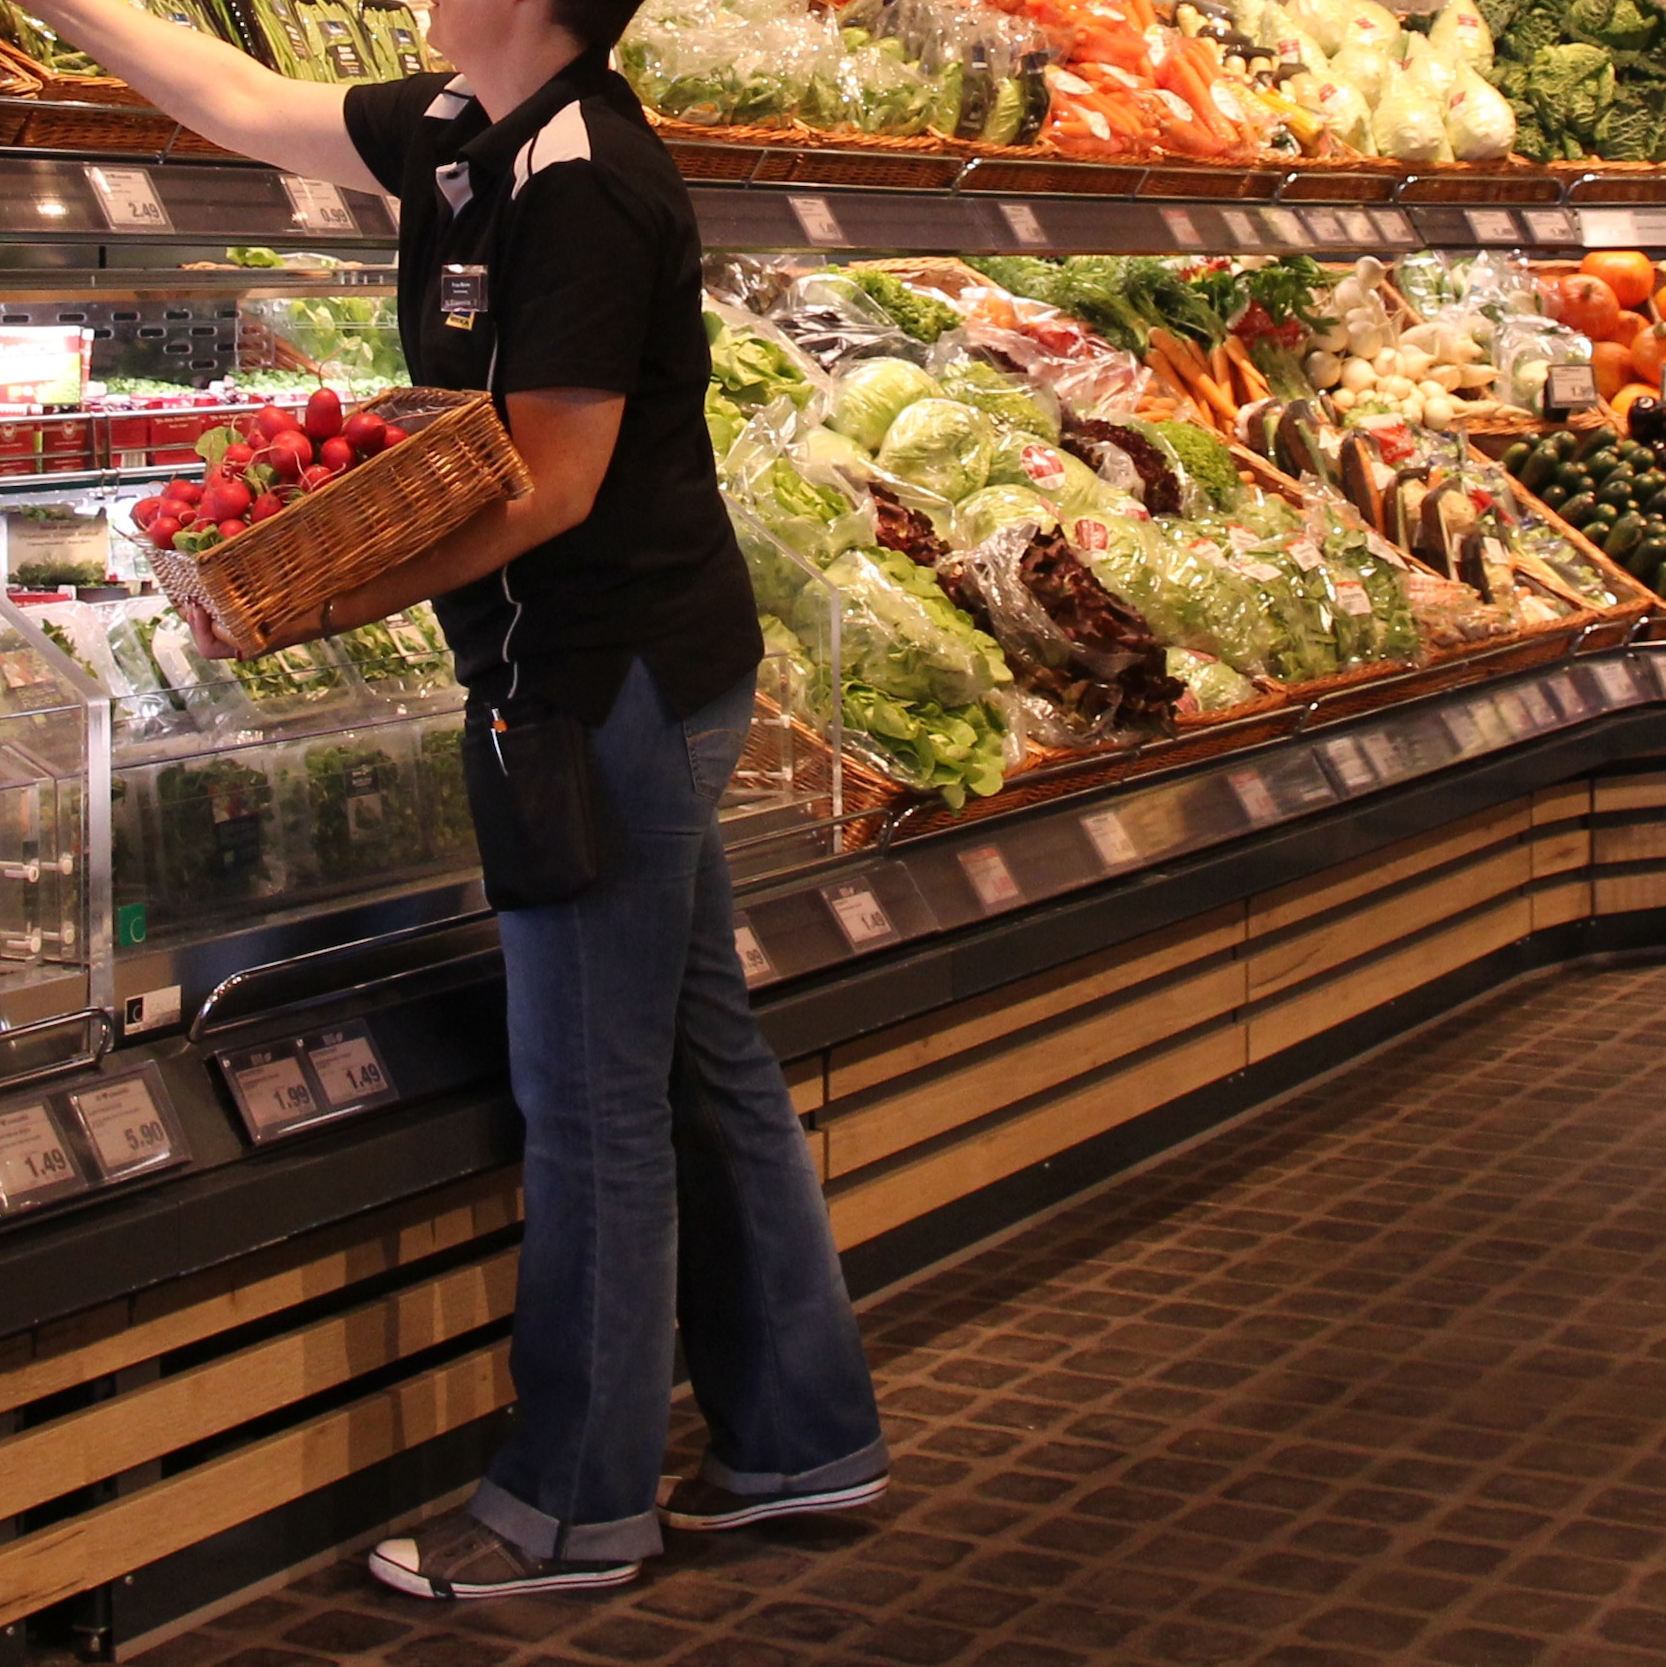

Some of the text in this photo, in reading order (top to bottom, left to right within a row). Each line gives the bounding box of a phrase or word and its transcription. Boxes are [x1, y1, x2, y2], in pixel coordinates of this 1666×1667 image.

[346, 1063, 381, 1090] 1.49
[274, 1085, 311, 1111] 1.99
[124, 1120, 165, 1151] 5.90
[25, 1148, 67, 1178] 1.49
